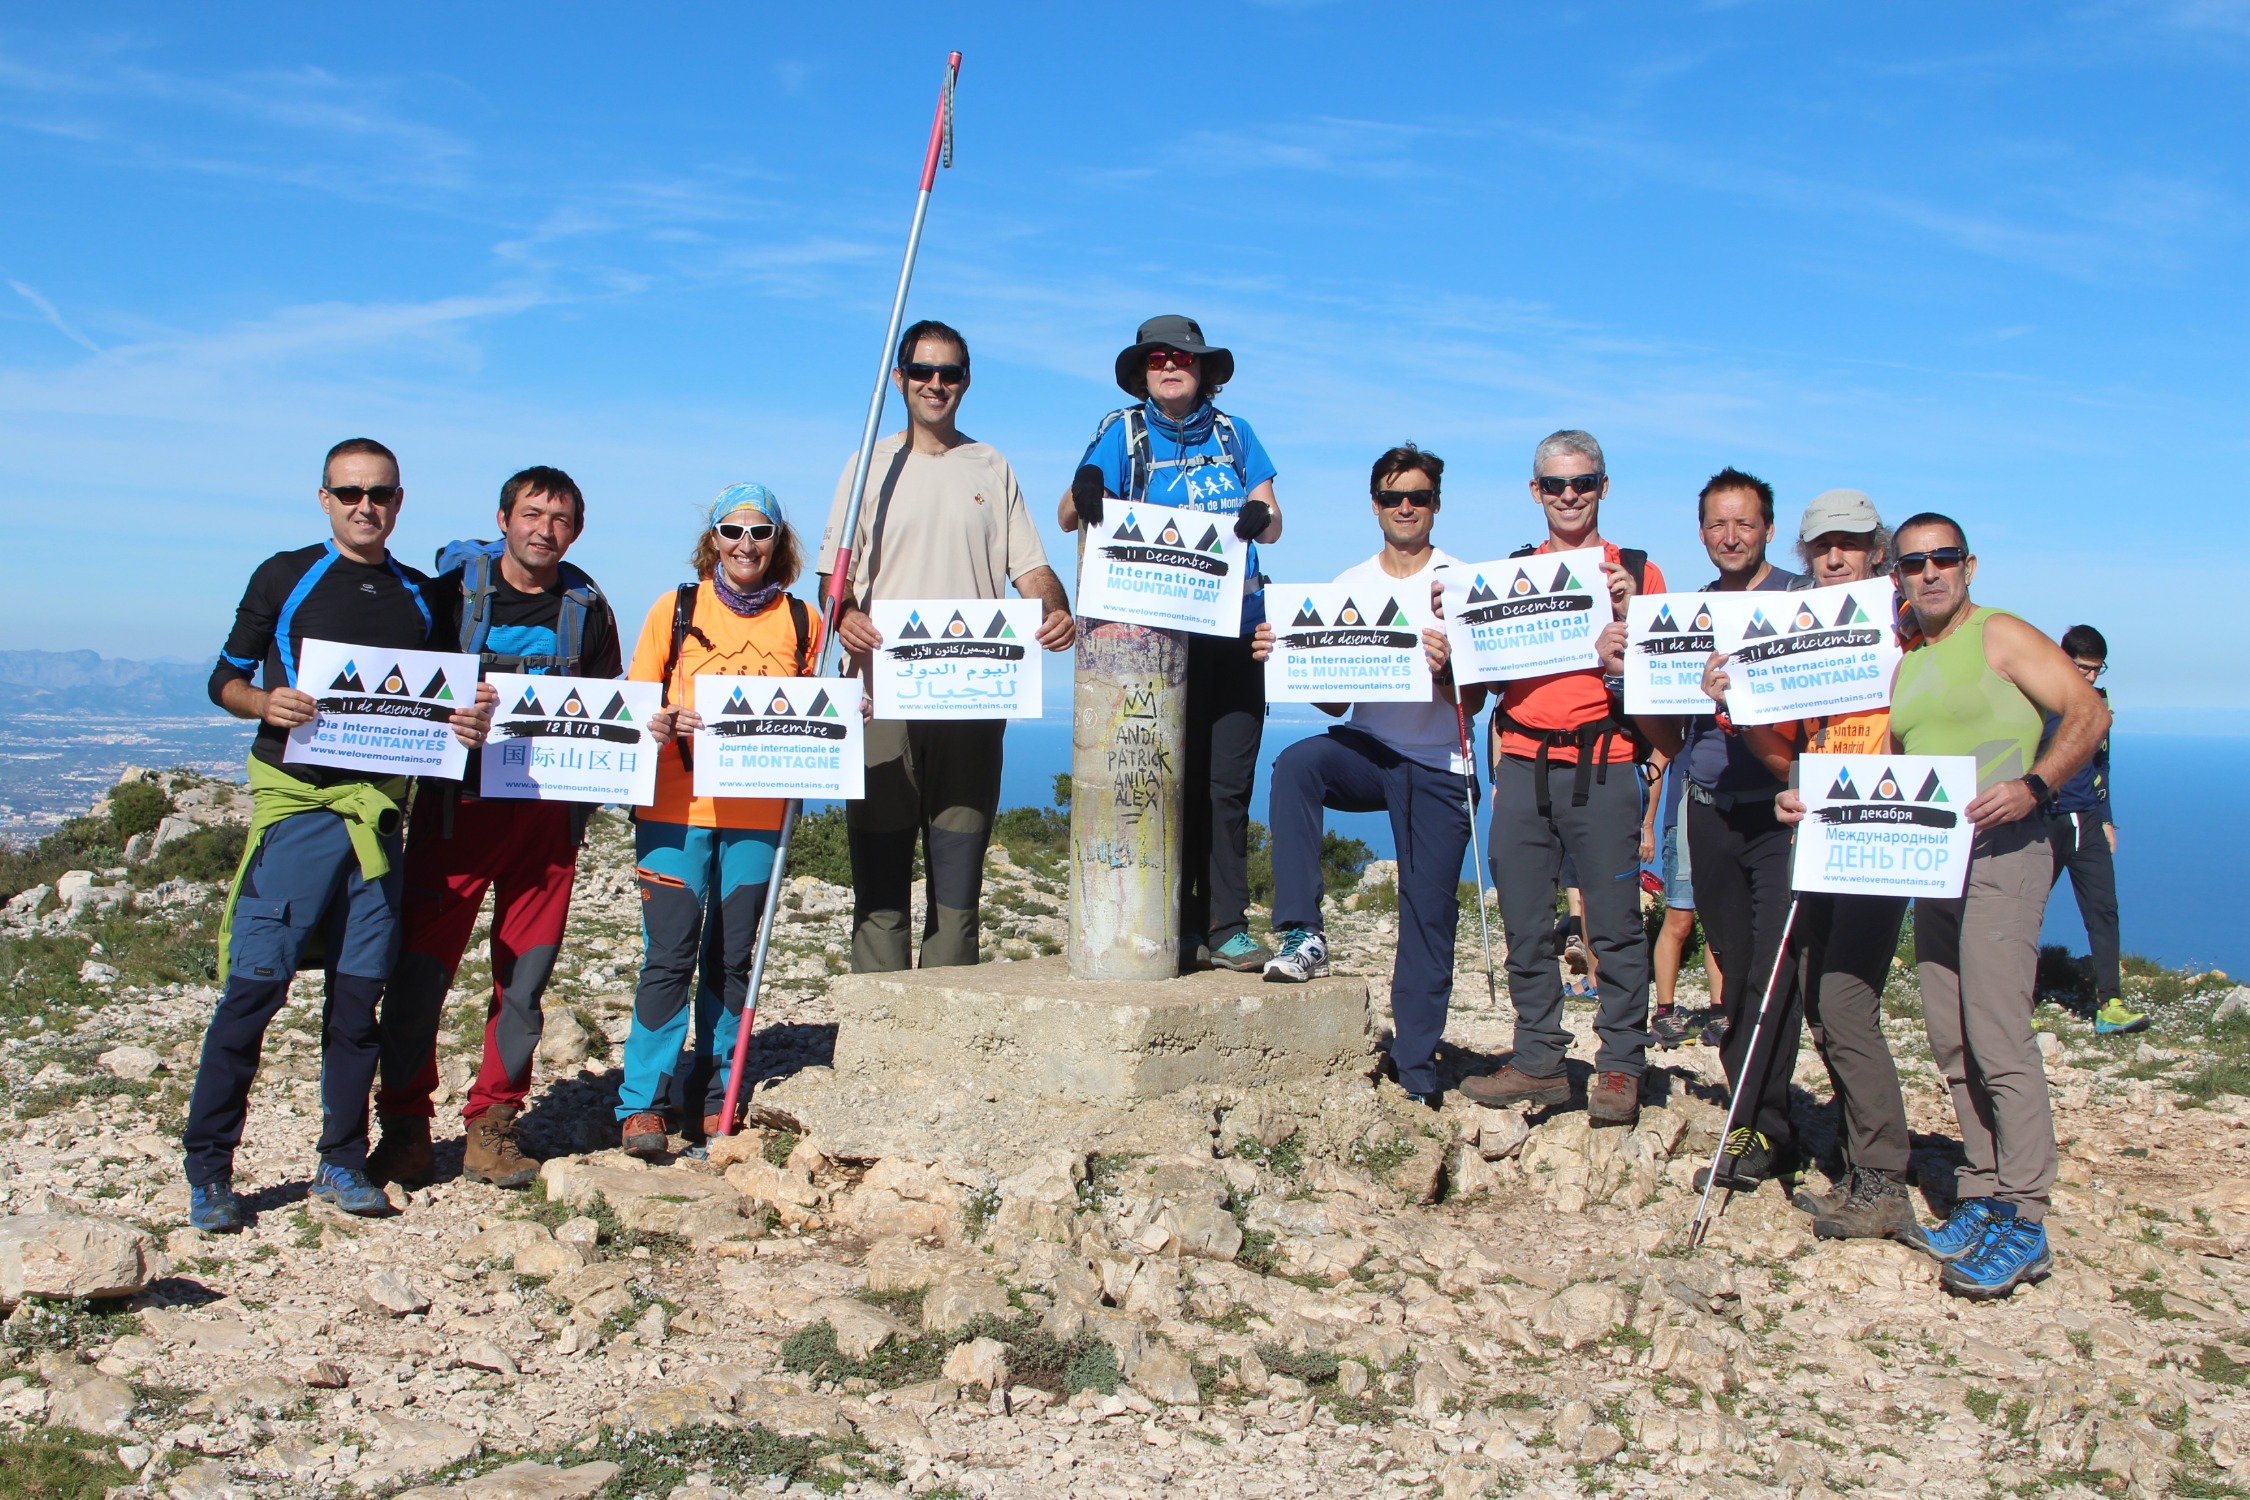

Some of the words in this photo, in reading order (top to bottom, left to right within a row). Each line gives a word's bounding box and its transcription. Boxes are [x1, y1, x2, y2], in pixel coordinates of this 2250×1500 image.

[1178, 503, 1204, 511] Grpo
[1208, 500, 1217, 511] de
[1127, 550, 1136, 559] 11
[1146, 550, 1212, 570] December
[1108, 564, 1221, 588] International
[1107, 577, 1188, 597] MOUNTAIN
[1193, 589, 1220, 603] DAY
[1103, 604, 1216, 626] www.welovemountains.org
[1483, 610, 1493, 619] 11
[1502, 597, 1573, 615] December
[1472, 614, 1589, 638] International
[1306, 636, 1316, 645] 11
[1320, 632, 1333, 645] de
[1338, 631, 1389, 645] desembre
[1474, 632, 1555, 652] MOUNTAIN
[1561, 625, 1590, 640] DAY
[1654, 642, 1663, 652] 11
[1670, 639, 1685, 650] de
[1751, 649, 1761, 659] 11
[1767, 644, 1784, 655] de
[1791, 631, 1872, 651] diciembre
[1287, 655, 1307, 664] Dia
[1311, 655, 1391, 664] Internacional
[1397, 655, 1410, 663] de
[1478, 653, 1593, 672] www.welovemountains.org
[1649, 660, 1667, 668] Día
[1747, 667, 1767, 677] Día
[1772, 655, 1856, 674] Internacional
[1861, 653, 1876, 662] de
[966, 662, 1017, 681] اليوم
[1288, 667, 1308, 677] les
[1313, 666, 1411, 677] MUNTANYES
[1650, 673, 1671, 685] las
[1750, 681, 1775, 694] las
[1781, 664, 1880, 690] MONTAÑAS
[897, 680, 1017, 703] للجبال
[1287, 683, 1411, 691] www.welovemountains.org
[342, 702, 353, 711] 11
[357, 699, 372, 712] de
[377, 702, 431, 717] desembre
[899, 702, 1017, 710] www.welovemountains.org
[1755, 692, 1883, 714] www.welovemountains.org
[316, 719, 339, 730] Dia
[343, 722, 430, 737] Internacional
[434, 729, 448, 738] de
[736, 723, 746, 733] 11
[756, 721, 828, 736] décembre
[313, 730, 336, 742] les
[342, 733, 446, 751] MUNTANYES
[719, 744, 758, 753] Journée
[761, 744, 826, 753] internationale
[829, 745, 840, 753] de
[310, 747, 442, 765] www.welovemountains.org
[503, 744, 637, 772] 国际山区日
[719, 755, 733, 768] la
[742, 755, 840, 769] MONTAGNE
[1107, 747, 1172, 774] PATRICK
[505, 780, 629, 795] www.welovemountains.org
[719, 781, 839, 790] www.welovemountains.org
[1114, 768, 1160, 791] ANITA
[1115, 790, 1157, 810] ALEX
[1842, 810, 1852, 820] 11
[1860, 808, 1912, 821] декабря
[1826, 828, 1948, 846] Международный
[1825, 845, 1894, 872] ДЕНЬ
[1902, 848, 1949, 872] ГОР
[1823, 874, 1945, 888] www.welovemountains.org
